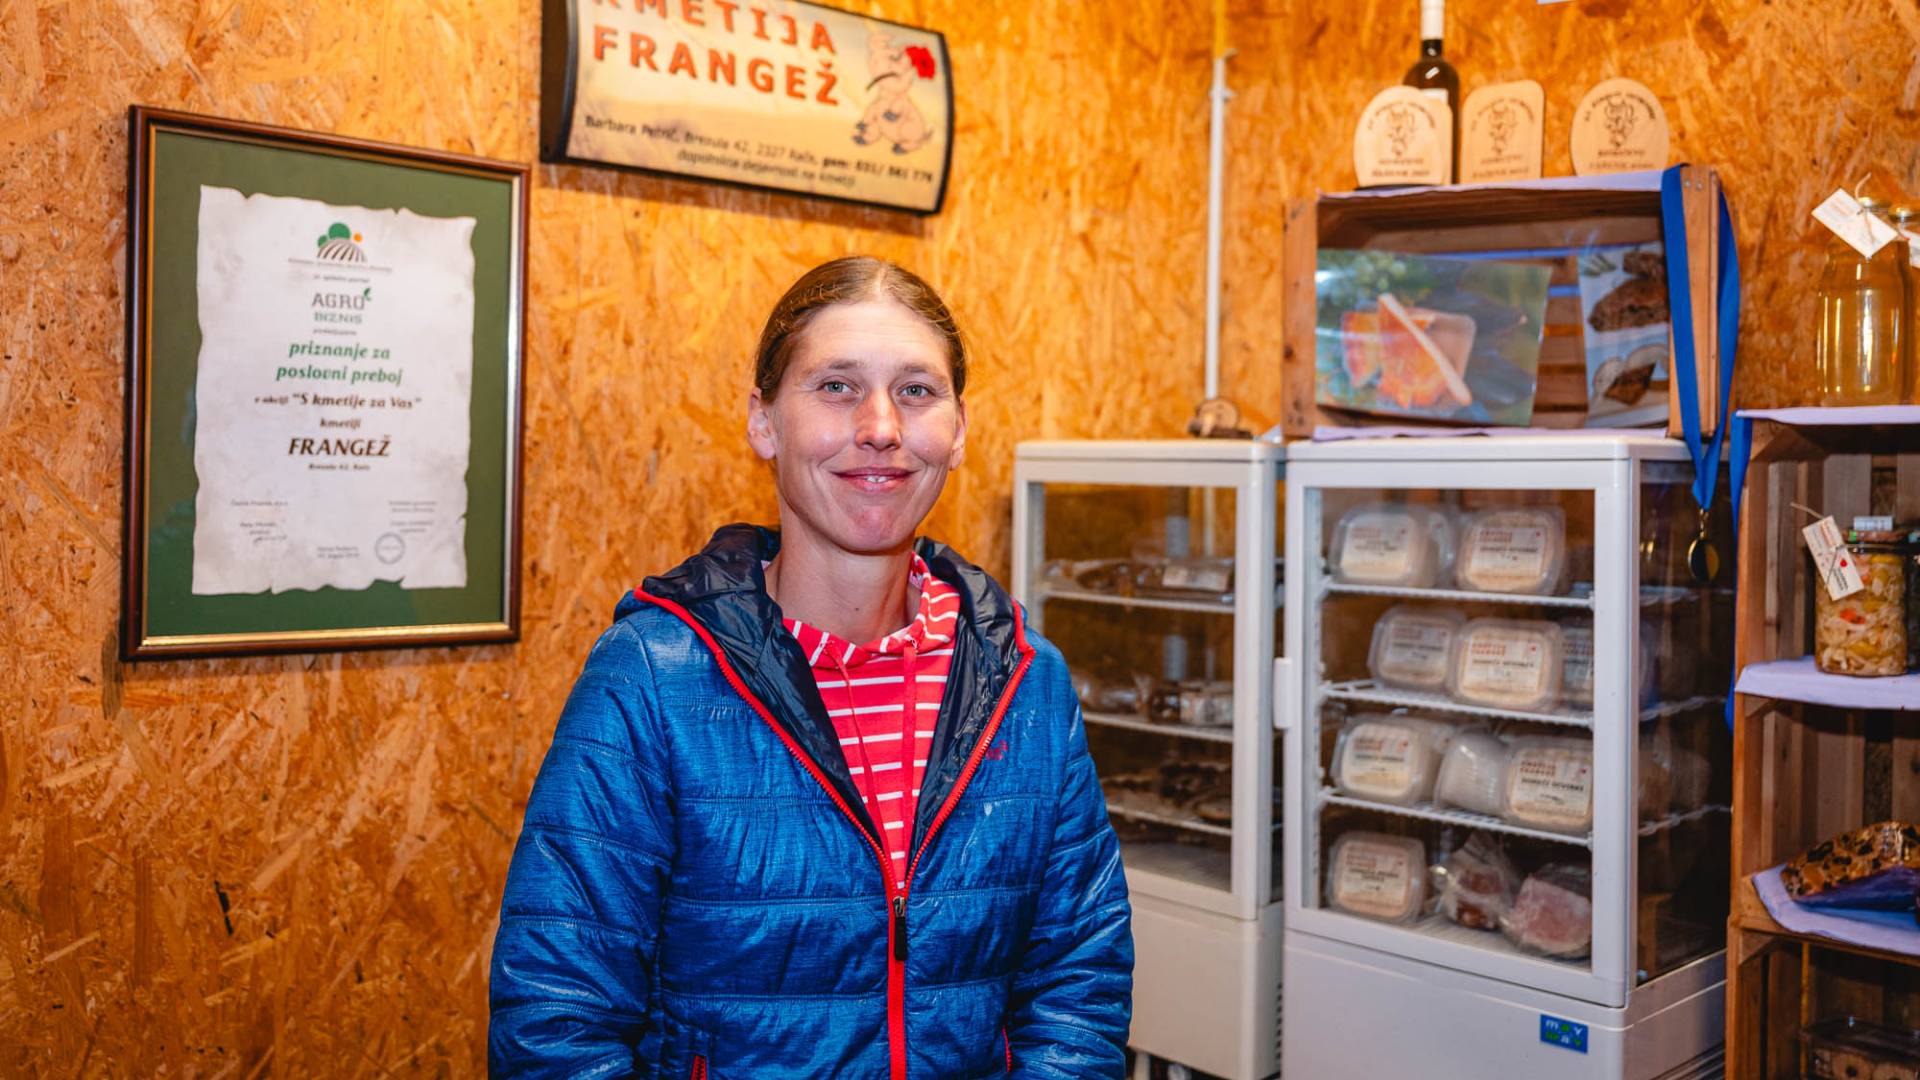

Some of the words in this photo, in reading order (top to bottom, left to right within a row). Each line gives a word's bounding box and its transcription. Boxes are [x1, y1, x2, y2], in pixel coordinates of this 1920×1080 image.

[595, 0, 836, 55] METIJA
[593, 24, 838, 106] FRANGEŽ
[585, 115, 636, 134] Barbara
[312, 292, 366, 311] AGRO
[314, 311, 363, 324] BIZNIS
[288, 340, 369, 361] priznanje
[372, 347, 391, 359] za
[275, 364, 348, 381] poslovni
[351, 367, 403, 388] preboj
[312, 393, 366, 409] kmetije
[369, 397, 386, 408] za
[319, 417, 361, 430] kmetiji
[287, 434, 392, 457] FRANGEŽ
